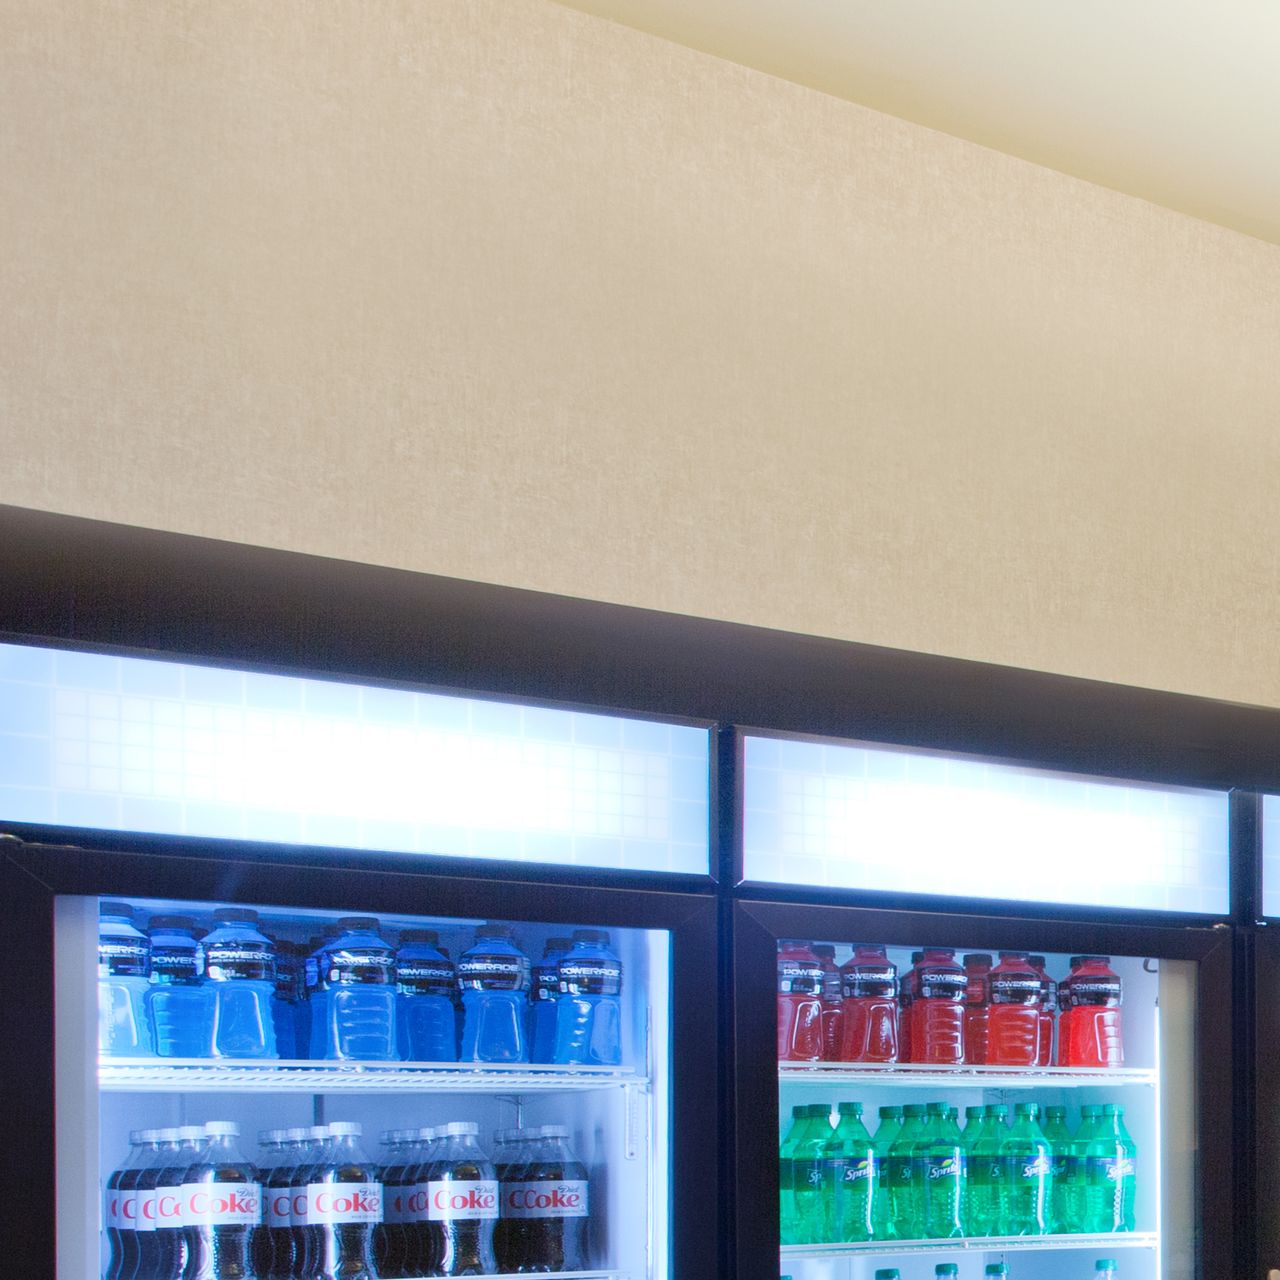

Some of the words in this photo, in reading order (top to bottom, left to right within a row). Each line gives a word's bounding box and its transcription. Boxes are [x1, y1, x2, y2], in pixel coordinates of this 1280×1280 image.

[189, 1192, 258, 1215] Coke
[315, 1190, 381, 1213] Coke
[434, 1188, 496, 1210] Coke
[523, 1188, 581, 1210] Coke
